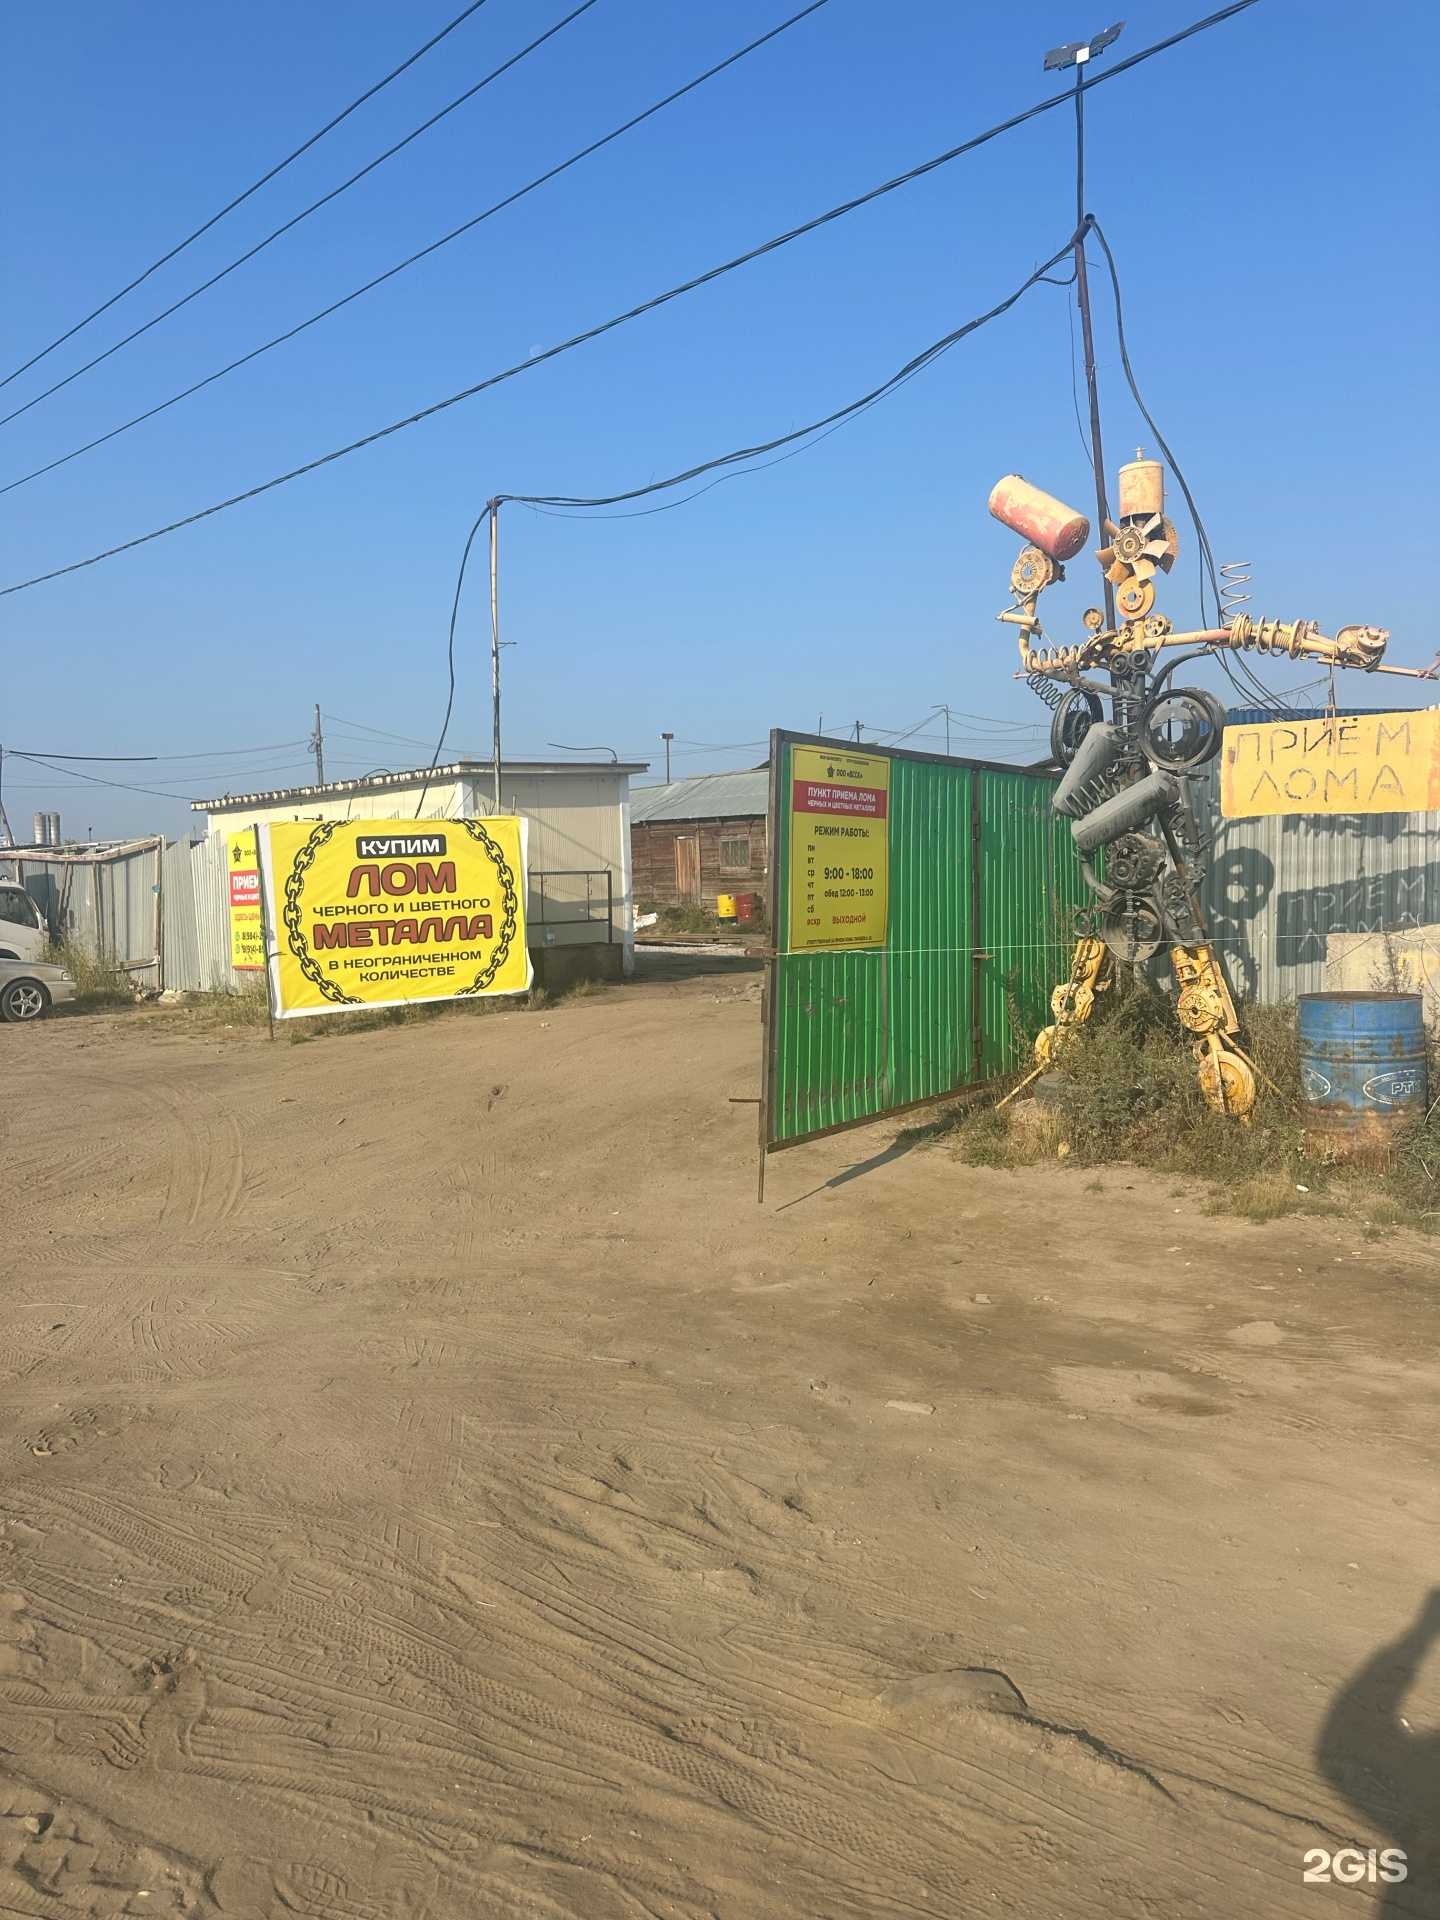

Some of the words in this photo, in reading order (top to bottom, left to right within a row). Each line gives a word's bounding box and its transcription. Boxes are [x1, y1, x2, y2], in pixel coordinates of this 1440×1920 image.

[1251, 765, 1405, 802] ЛОМА
[808, 787, 831, 798] ПУНКТ
[832, 790, 857, 801] ПРИЕМА
[858, 792, 876, 803] ЛОМА
[808, 800, 827, 808] ЧЕРНЫХ
[814, 826, 840, 837] РЕЖИМ
[361, 838, 440, 856] КУПИМ
[346, 861, 457, 898] ЛОМ
[808, 870, 815, 878] ср
[824, 867, 844, 880] 9:00
[851, 867, 873, 880] 18:00
[824, 889, 839, 898] обед
[840, 888, 855, 897] 12:00
[313, 902, 389, 917] ЧЕРНОГО
[393, 902, 405, 913] И
[410, 898, 491, 914] ЦВЕТНОГО
[807, 905, 814, 913] сб
[832, 913, 866, 925] ВЫХОДНОЙ
[313, 914, 493, 951] МЕТАЛЛА
[329, 961, 338, 970] В
[343, 950, 482, 970] НЕОГРАНИЧЕННОМ
[359, 966, 455, 982] КОЛИЧЕСТВЕ
